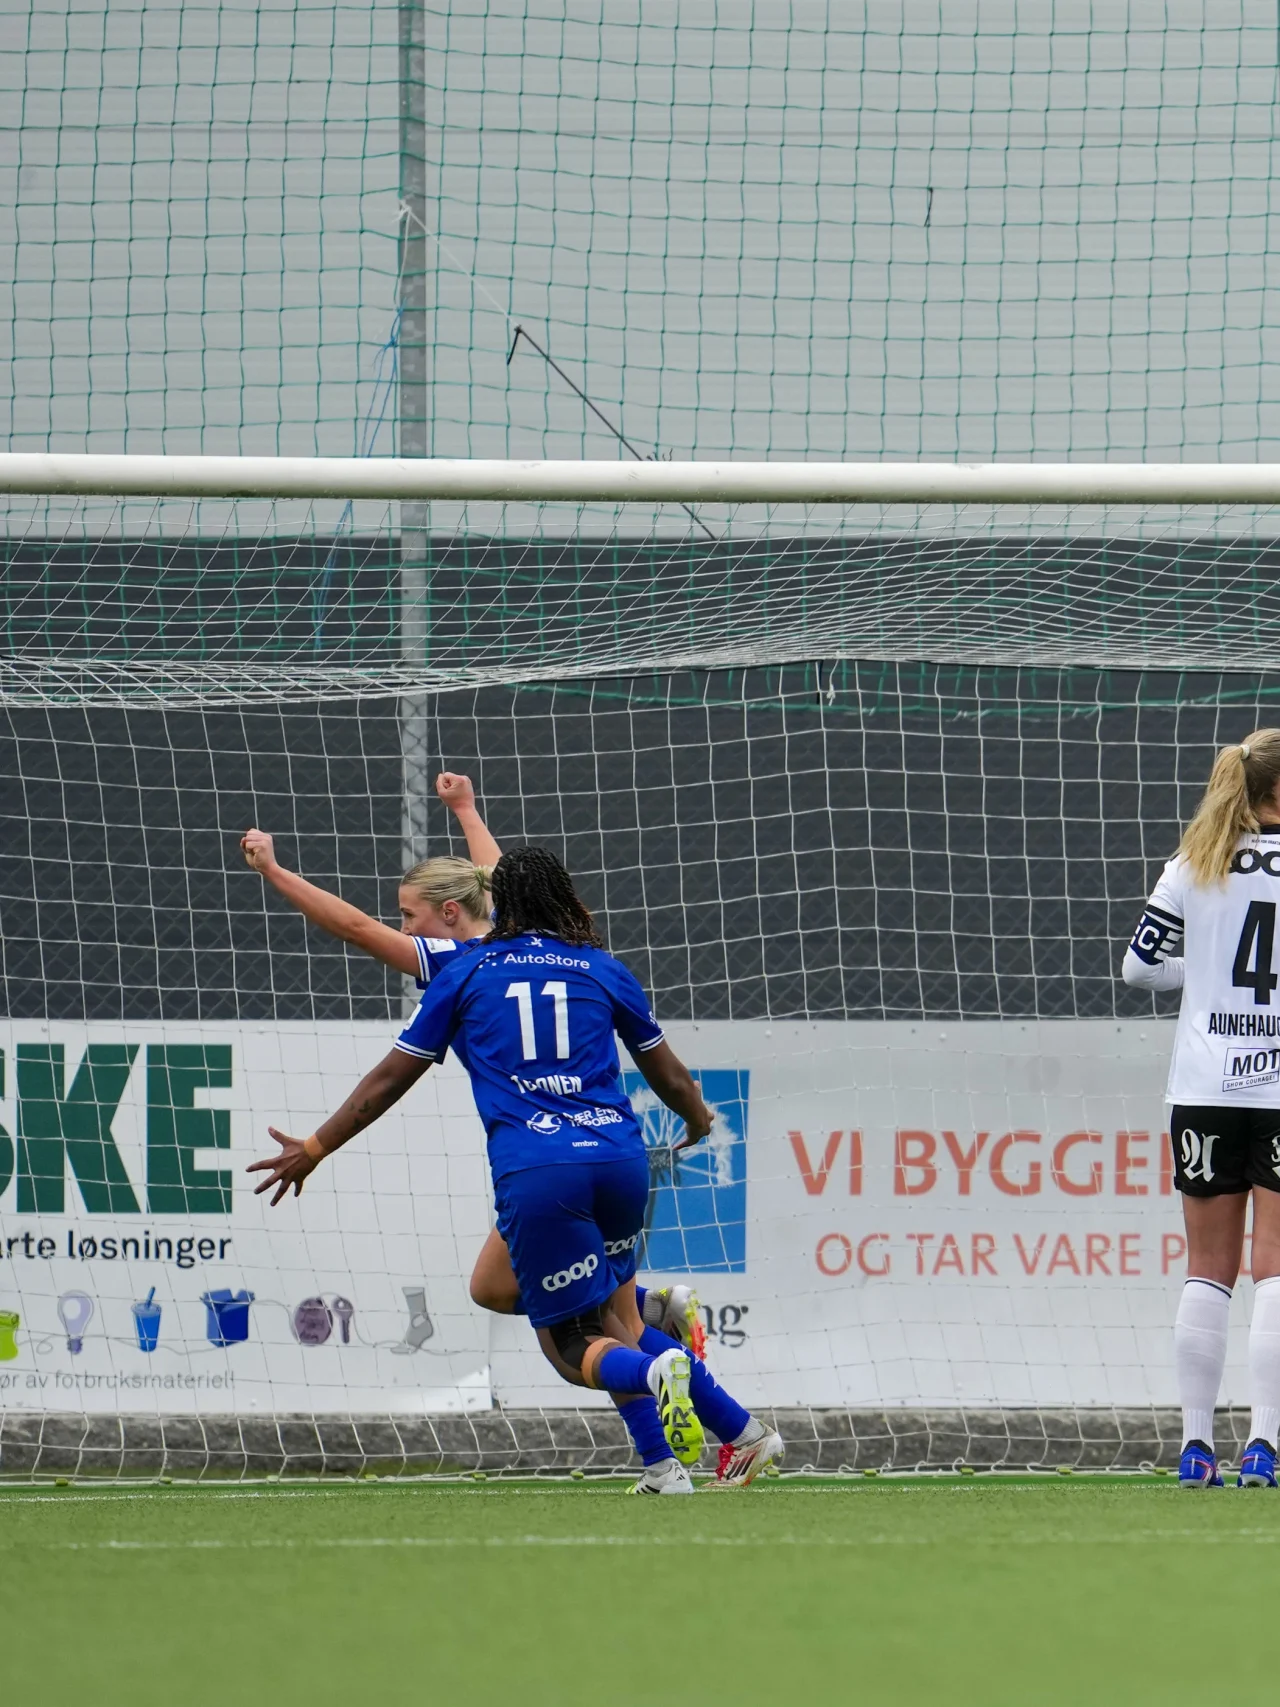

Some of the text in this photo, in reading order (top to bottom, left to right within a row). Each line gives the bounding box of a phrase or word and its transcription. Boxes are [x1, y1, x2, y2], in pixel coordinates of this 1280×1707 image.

[503, 952, 591, 970] AutoStore
[1232, 901, 1278, 1005] 4
[505, 981, 570, 1061] 11
[1231, 1048, 1280, 1077] MOT
[0, 1043, 232, 1214] KE
[572, 1140, 599, 1148] umbro
[788, 1130, 863, 1196] VI
[0, 1230, 232, 1269] rte løsninger
[815, 1233, 890, 1277] OG
[905, 1233, 998, 1276] TAR
[1012, 1233, 1142, 1276] VARE
[541, 1253, 599, 1292] coop
[25, 1373, 49, 1389] av
